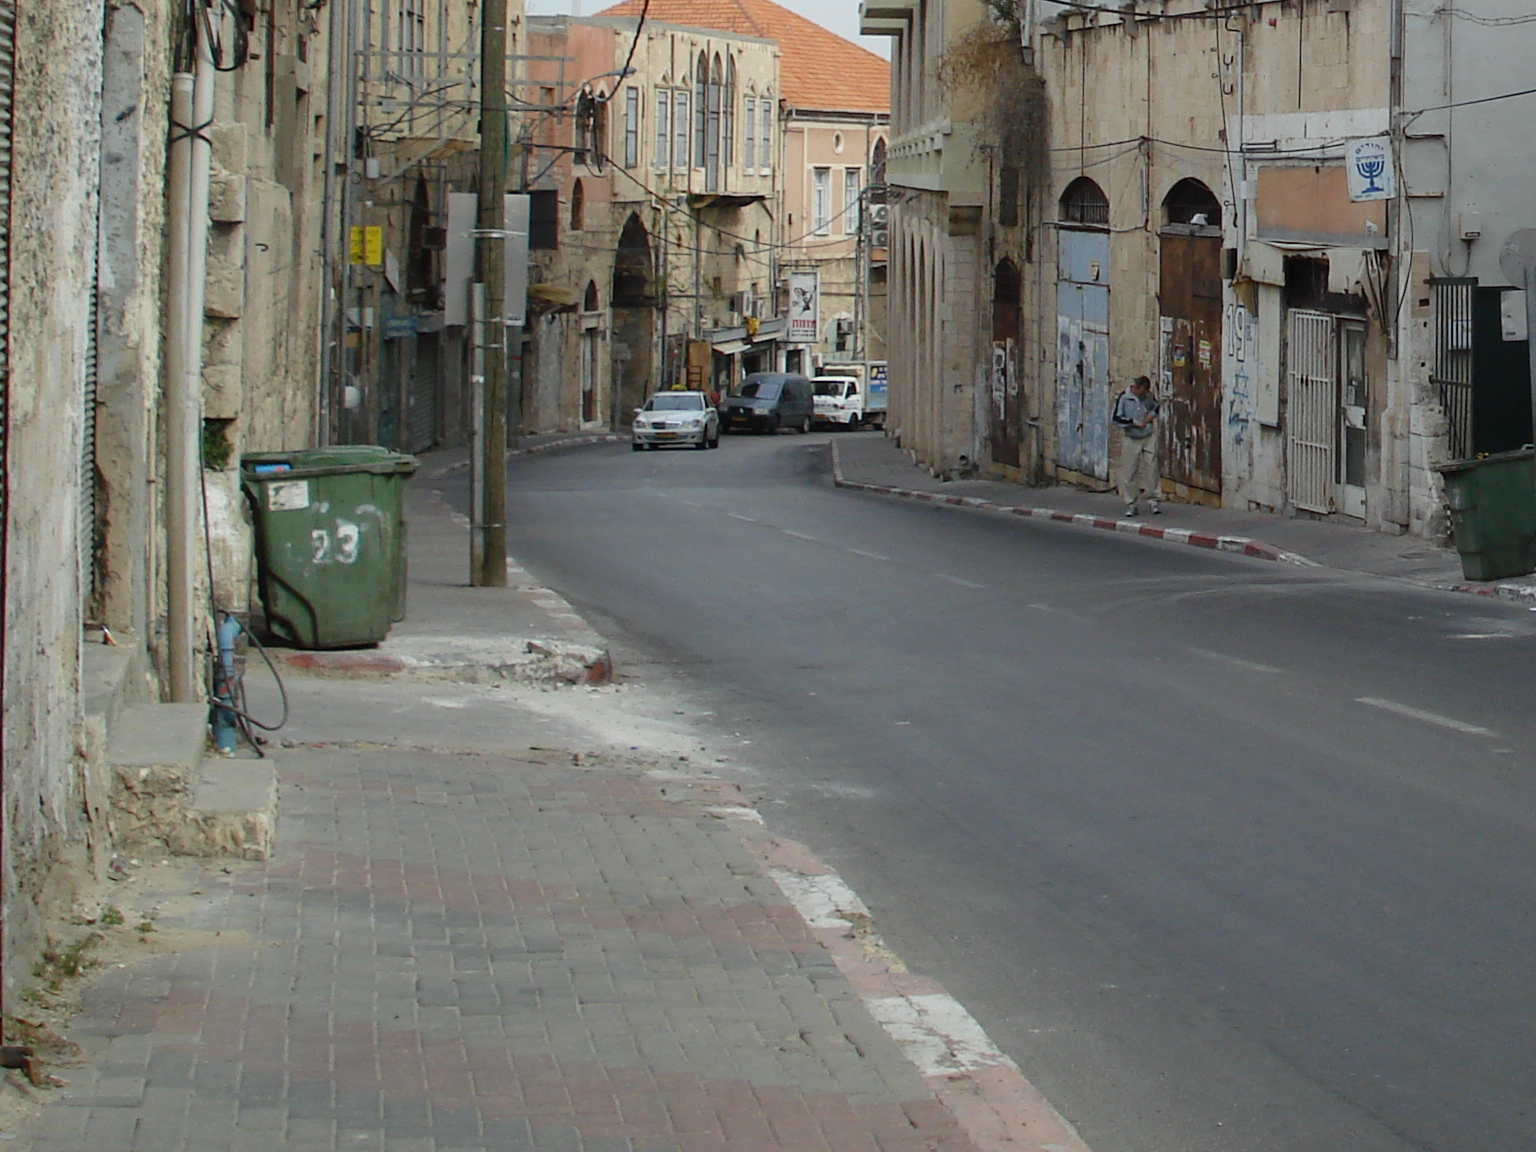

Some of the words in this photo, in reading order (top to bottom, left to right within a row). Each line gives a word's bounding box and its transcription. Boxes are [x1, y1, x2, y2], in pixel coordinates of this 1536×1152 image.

[1355, 143, 1384, 155] יהודים
[1226, 304, 1246, 363] 19
[311, 519, 360, 565] 23
